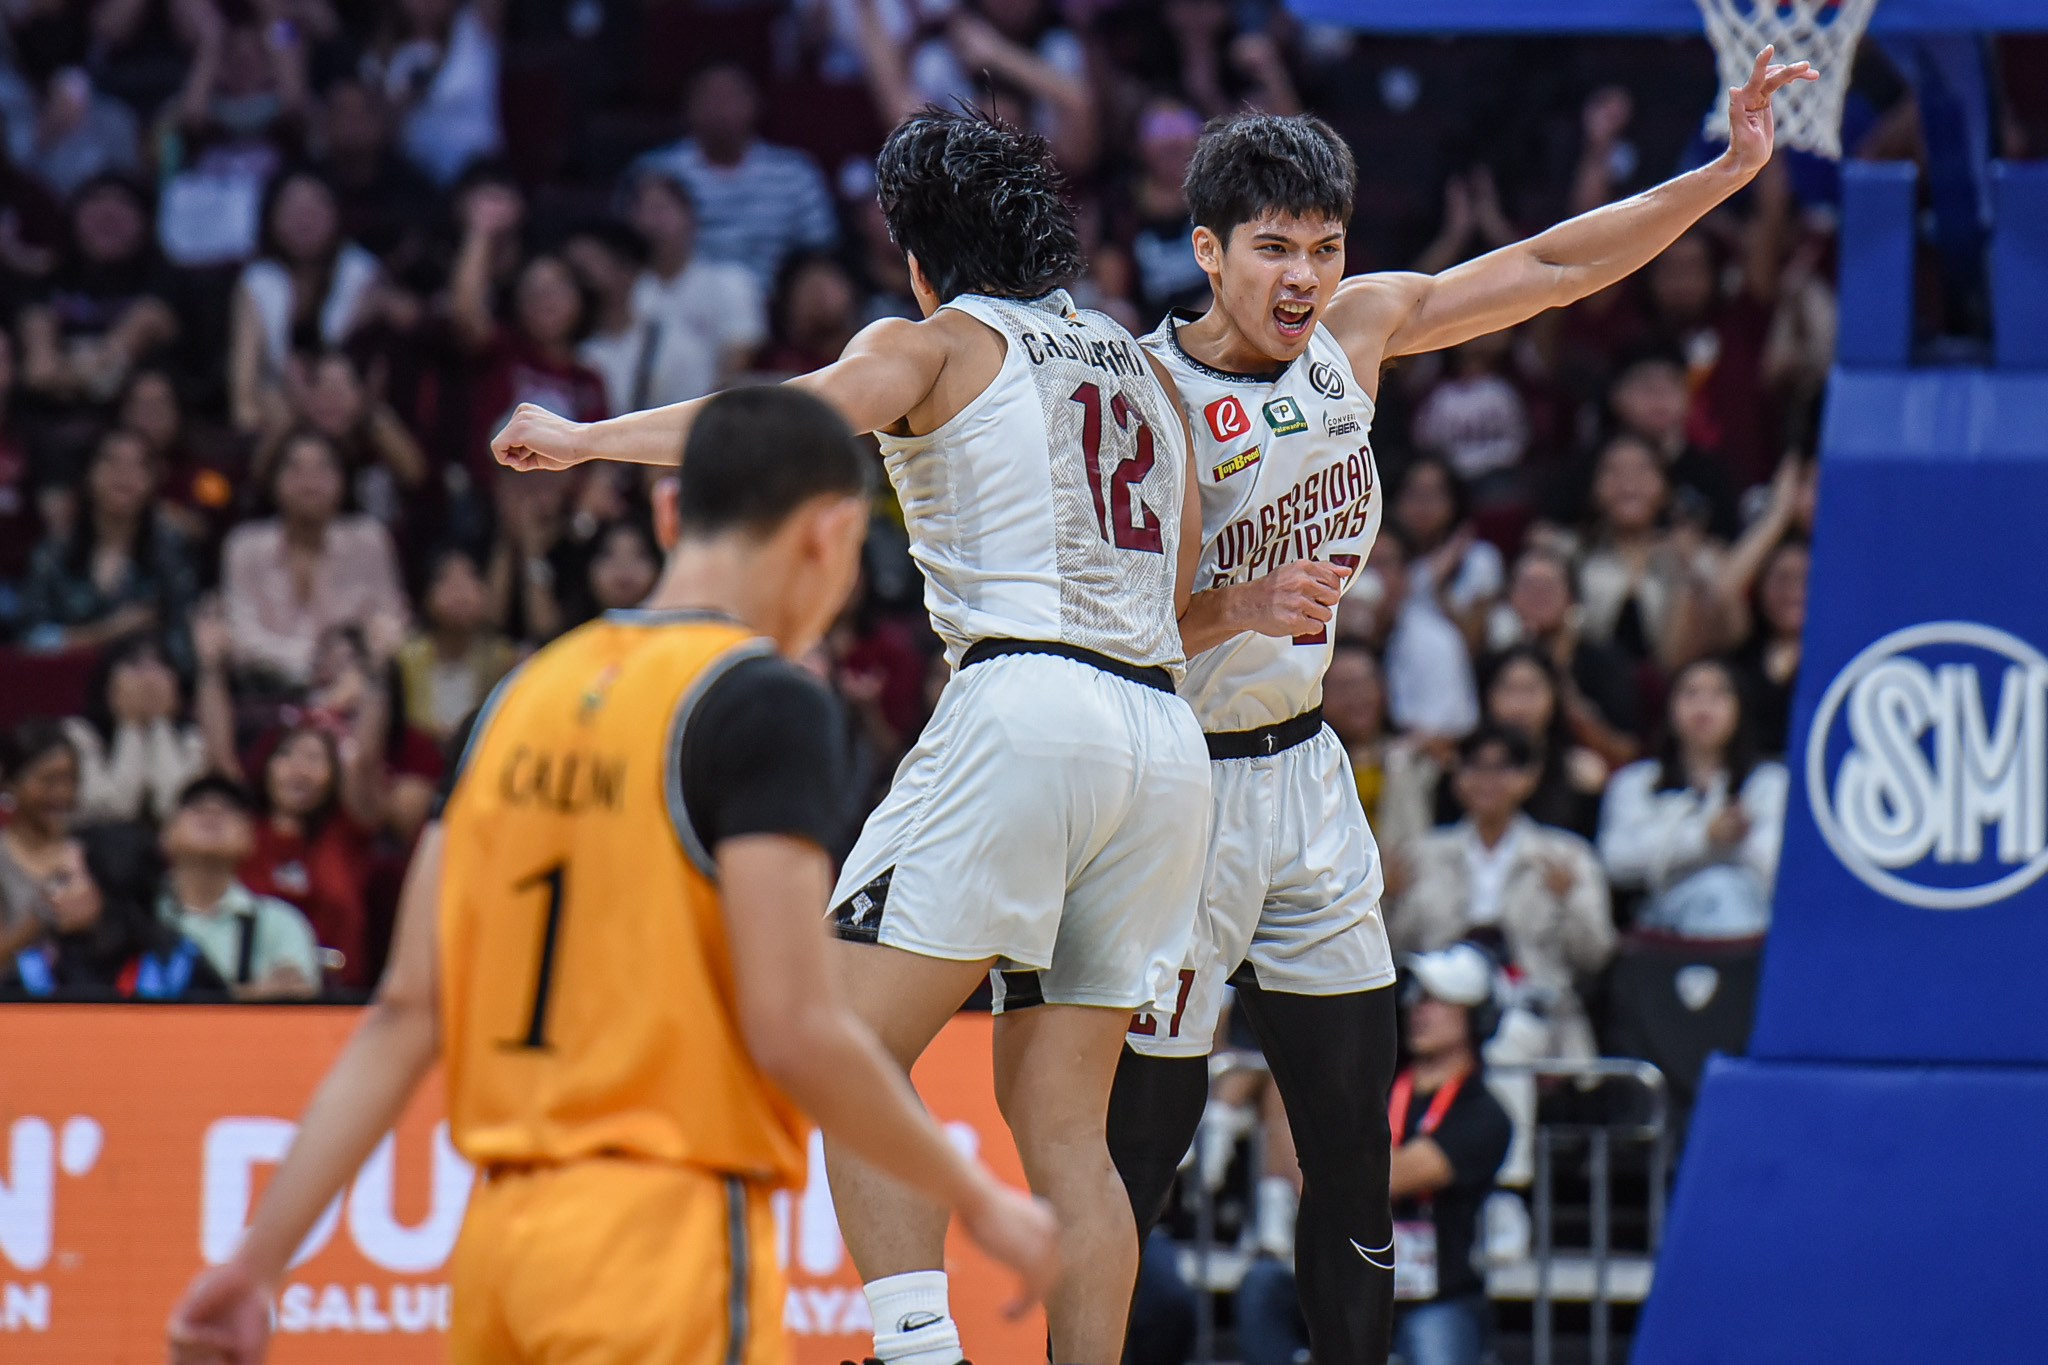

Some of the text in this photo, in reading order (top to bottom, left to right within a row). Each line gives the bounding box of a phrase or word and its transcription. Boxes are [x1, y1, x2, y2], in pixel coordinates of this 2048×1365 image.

[1070, 381, 1164, 555] 12
[1213, 447, 1260, 480] TopBreed
[1272, 421, 1307, 434] PalawanPay
[1836, 655, 2047, 868] SM
[496, 863, 568, 1053] 1
